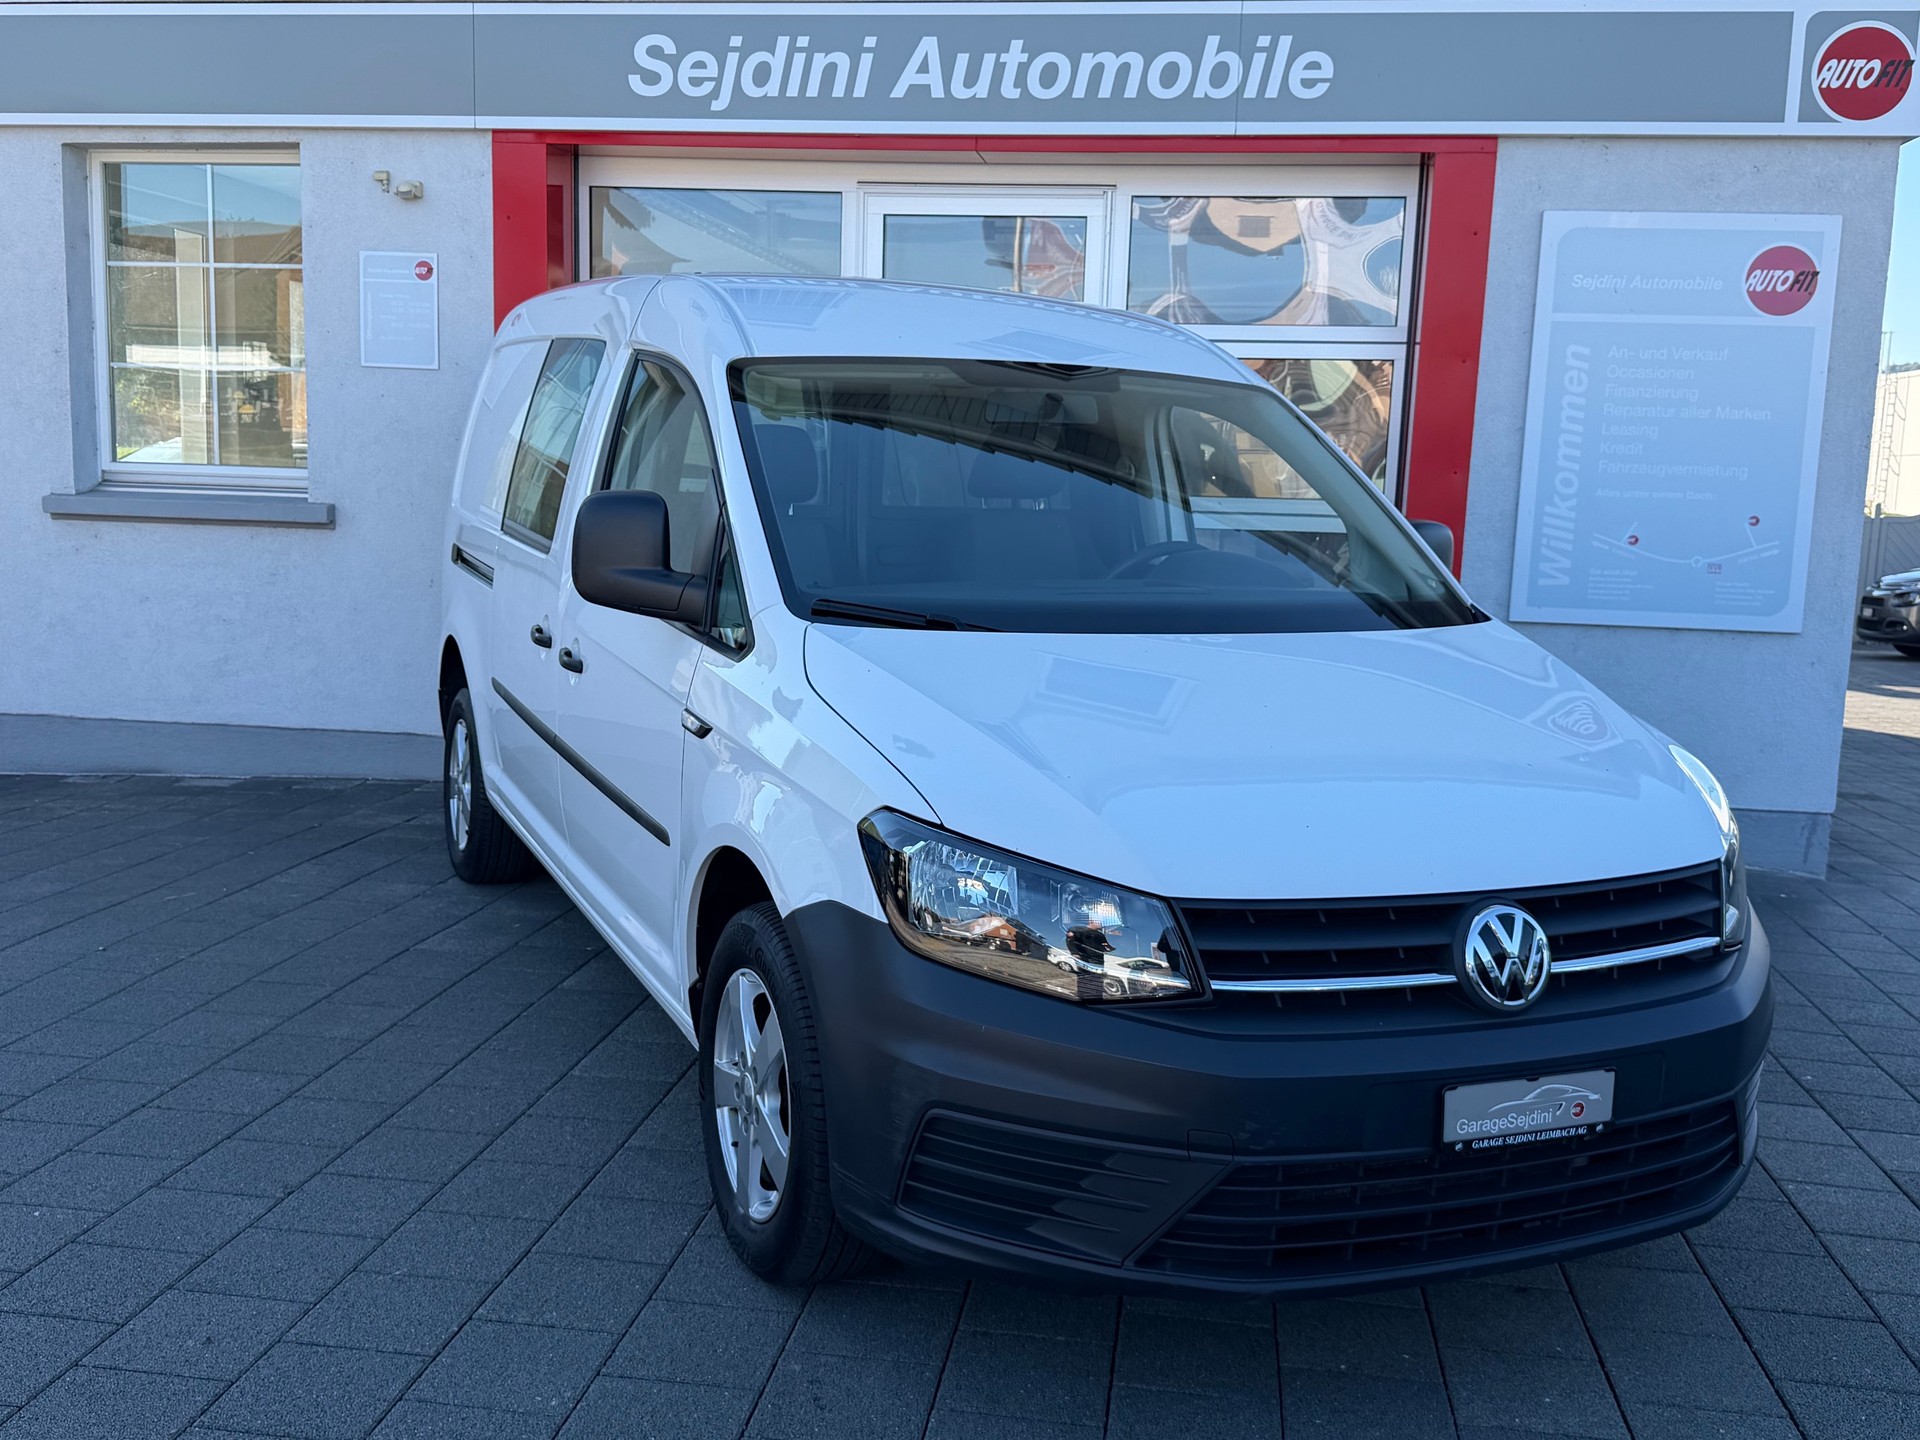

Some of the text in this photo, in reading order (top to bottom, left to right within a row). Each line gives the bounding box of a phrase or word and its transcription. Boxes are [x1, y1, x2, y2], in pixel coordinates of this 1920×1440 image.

[627, 34, 1335, 111] Sejdini Automobile
[1816, 58, 1916, 89] AUTOFIT
[1571, 273, 1724, 291] Sejdini Automobile
[1744, 268, 1820, 293] AUTOFIT
[1607, 345, 1729, 361] An- und Verkauf
[1606, 364, 1695, 380] Occasionen
[1605, 383, 1699, 402] Finanzierung
[1603, 403, 1772, 421] Reparatur aller Marken
[1601, 422, 1659, 440] Leasing
[1600, 441, 1644, 456] Kredit
[1538, 343, 1591, 587] Willkommen
[1598, 460, 1749, 480] Fahrzeugvermietung
[1456, 1108, 1553, 1135] GarageSejdini
[1471, 1124, 1587, 1150] GARAGE SEJDINI LEIMBACH AG
